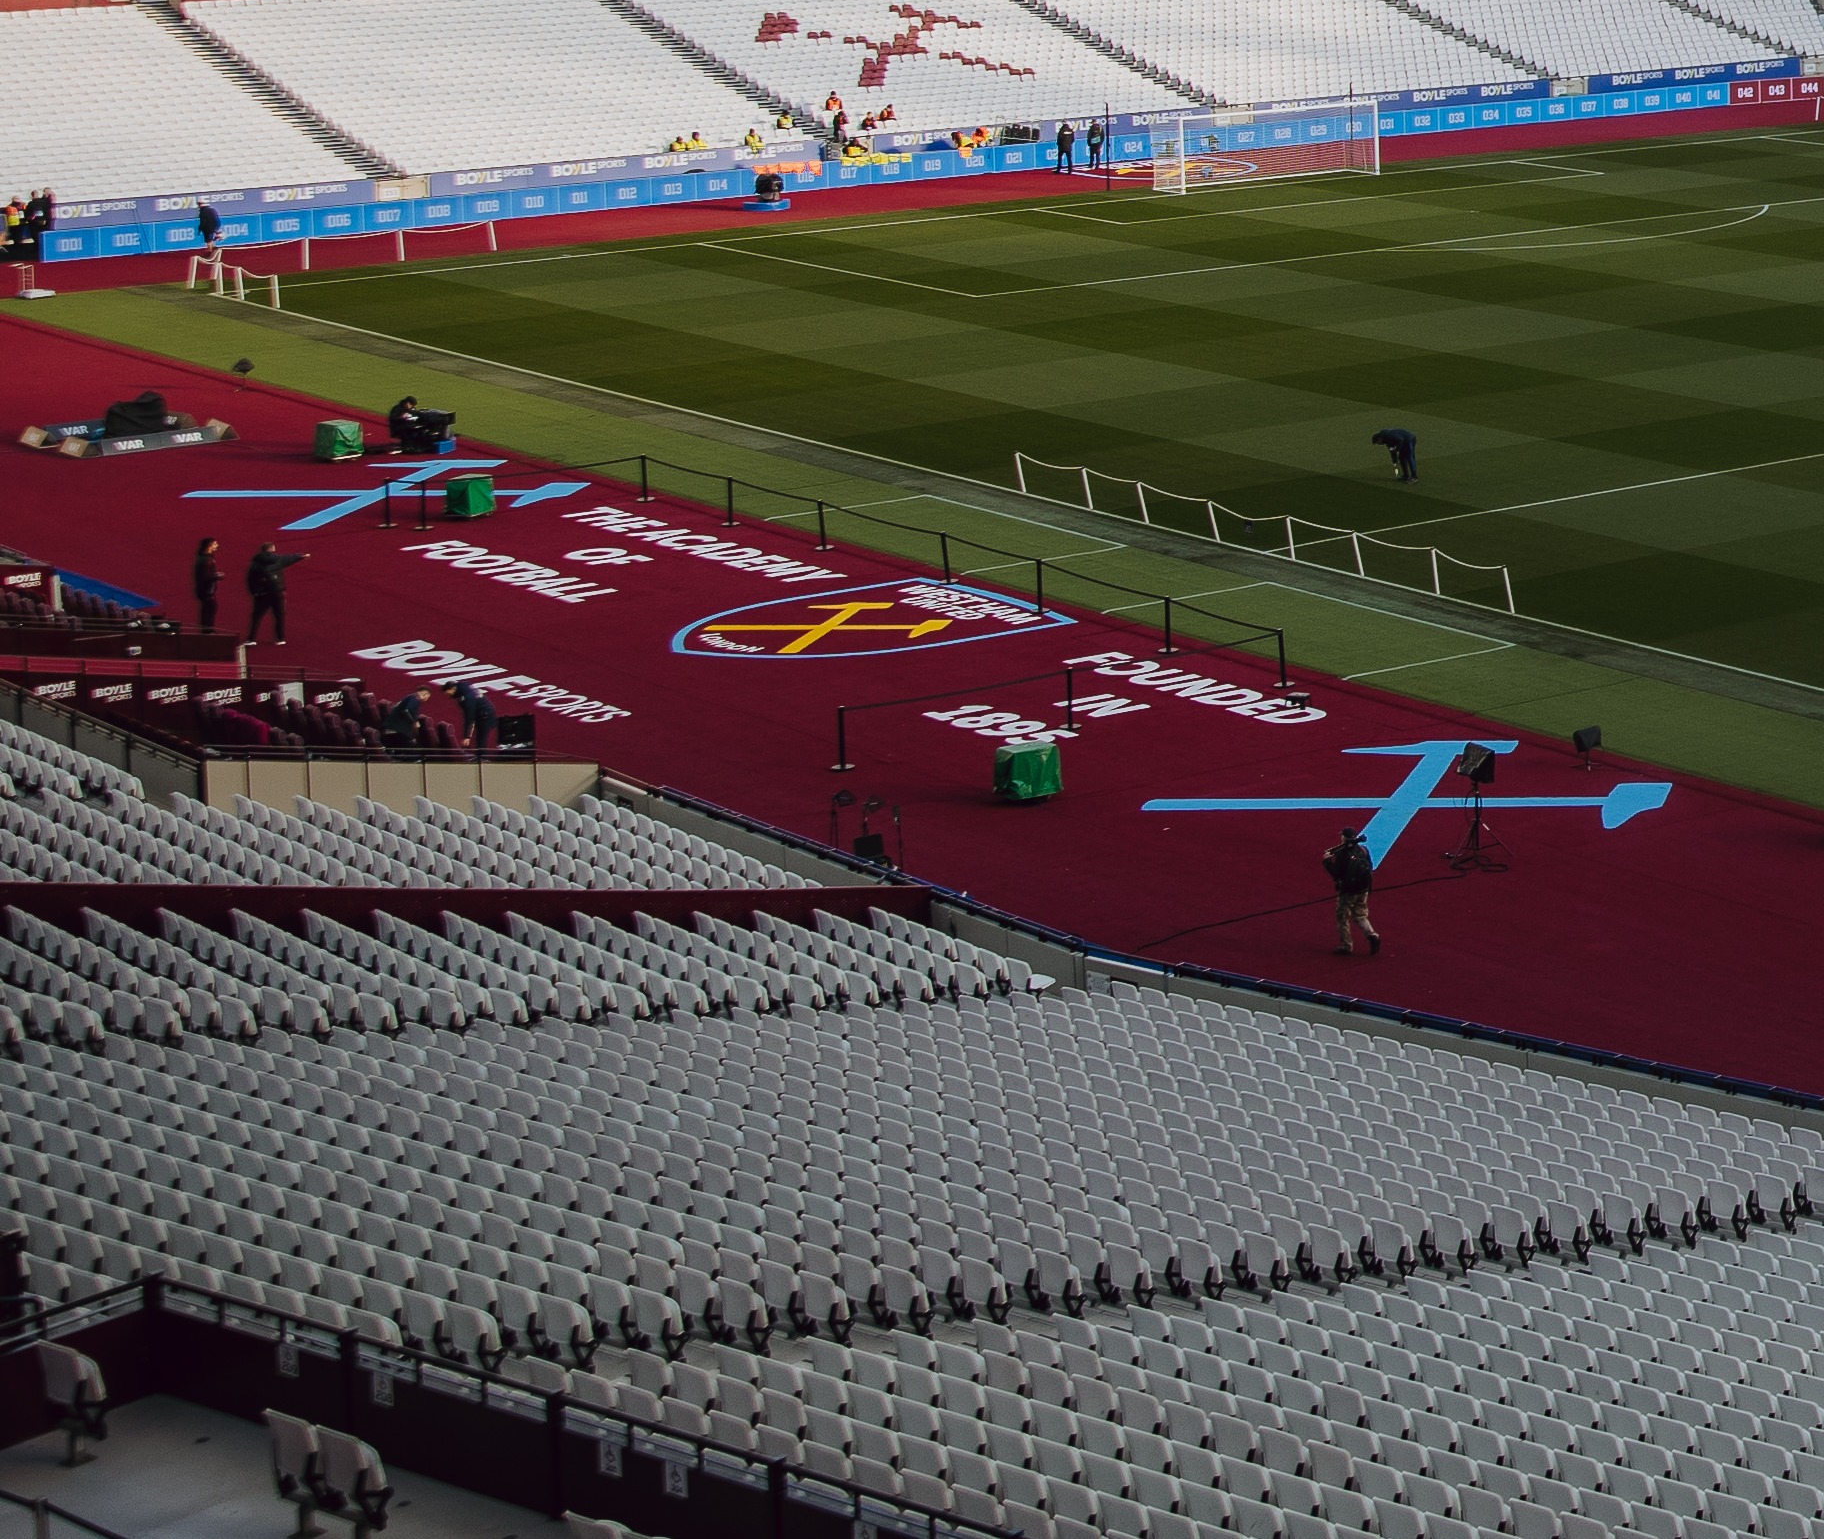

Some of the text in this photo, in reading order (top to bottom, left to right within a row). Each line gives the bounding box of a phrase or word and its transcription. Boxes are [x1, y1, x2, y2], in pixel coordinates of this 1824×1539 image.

[1675, 68, 1705, 80] BOYLE
[1738, 87, 1753, 98] 042
[1581, 101, 1596, 112] 037
[1414, 115, 1430, 126] 032
[456, 170, 502, 185] BOYLE
[264, 187, 314, 202] BOYLE
[618, 187, 636, 199] 012
[60, 425, 88, 436] VAR
[173, 432, 203, 443] VAR
[115, 440, 145, 451] VAR
[562, 506, 847, 583] THE ACADEMY
[563, 548, 655, 565] OF
[7, 572, 42, 585] BOYLE
[401, 540, 618, 603] FOOTBALL
[898, 584, 1041, 625] WEST HAM
[900, 596, 987, 620] UNITED
[699, 633, 764, 654] LONDON
[35, 680, 76, 695] BOYLE
[349, 640, 632, 723] BOYLE SPORTS
[1062, 651, 1327, 725] FOUNDED
[93, 684, 133, 698] BOYLE
[149, 685, 188, 700] BOYLE
[203, 686, 242, 702] BOYLE
[1053, 693, 1150, 718] IN
[922, 705, 1080, 745] 1895
